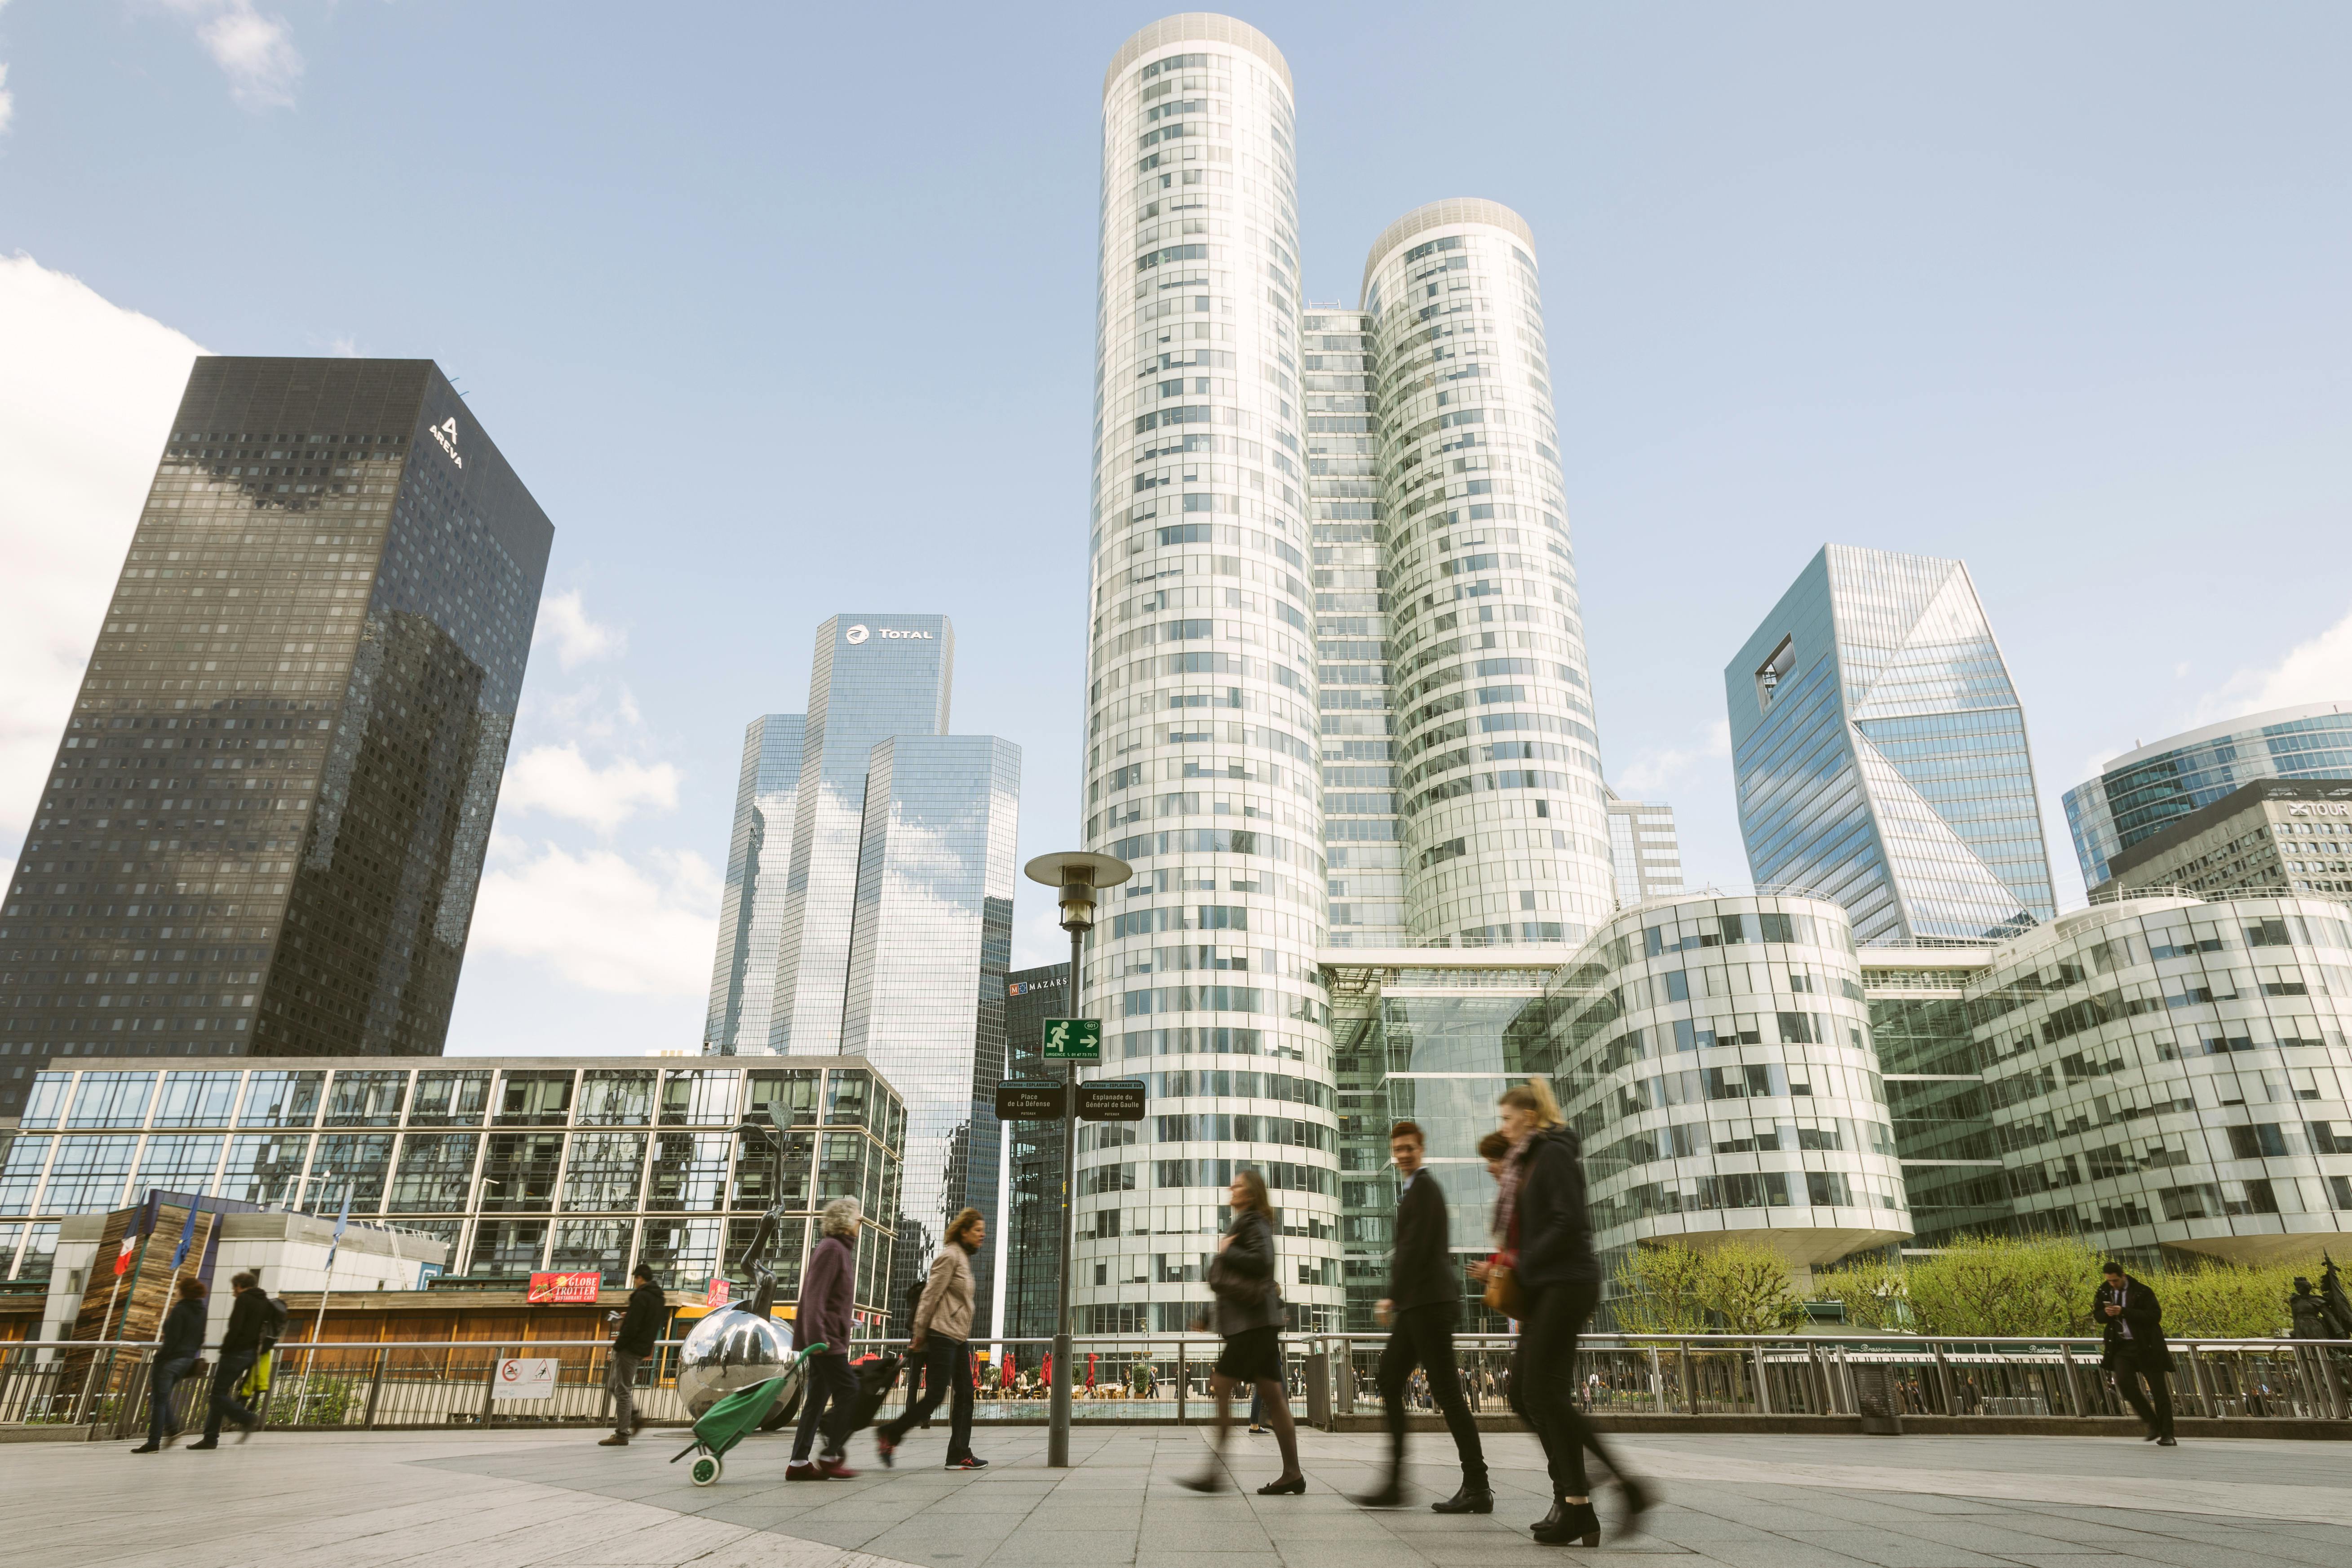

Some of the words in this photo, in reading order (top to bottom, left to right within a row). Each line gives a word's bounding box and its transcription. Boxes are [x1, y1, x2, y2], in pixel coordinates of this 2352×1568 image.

[429, 425, 462, 469] AREVA
[2307, 803, 2349, 815] TOUR
[1029, 978, 1067, 991] MAZARS
[568, 1278, 597, 1286] GLOBE
[555, 1286, 595, 1295] TROTTER
[1860, 1344, 1892, 1352] Brasserie
